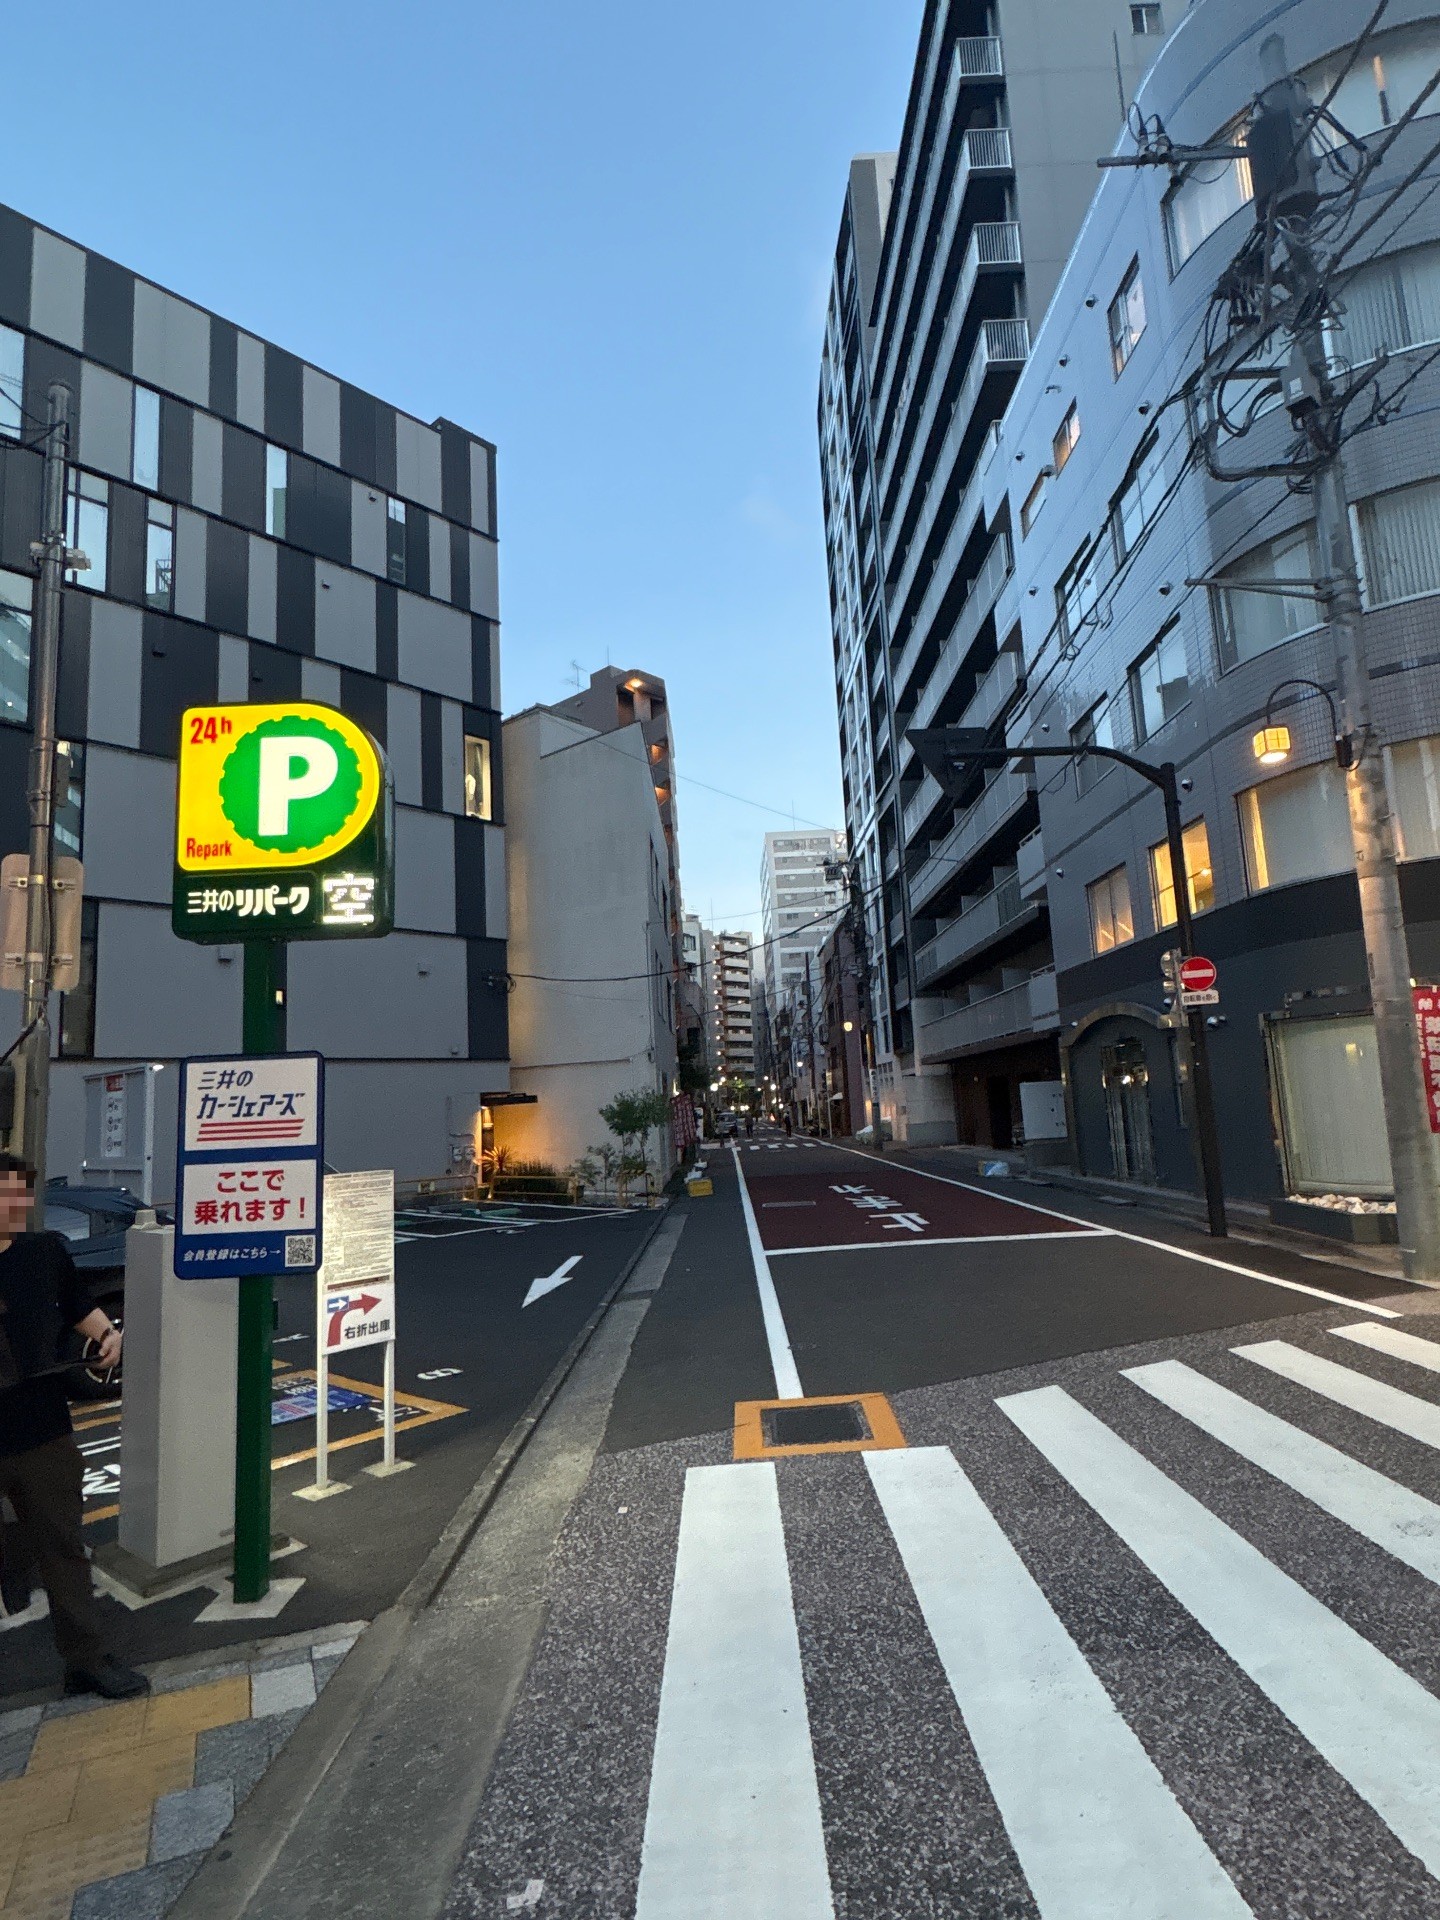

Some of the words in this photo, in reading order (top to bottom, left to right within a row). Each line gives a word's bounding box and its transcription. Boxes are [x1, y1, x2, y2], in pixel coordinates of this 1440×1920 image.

[190, 716, 232, 744] 24h
[258, 736, 339, 836] P
[186, 837, 232, 860] Repark
[187, 886, 310, 917] 三井のリパーク
[322, 870, 375, 926] 空
[197, 1069, 253, 1090] 三井の
[196, 1092, 305, 1119] カーシェアーズ
[217, 1169, 284, 1193] ここで
[183, 1246, 268, 1262] 会員登録はこちら
[344, 1319, 391, 1340] 右折出庫
